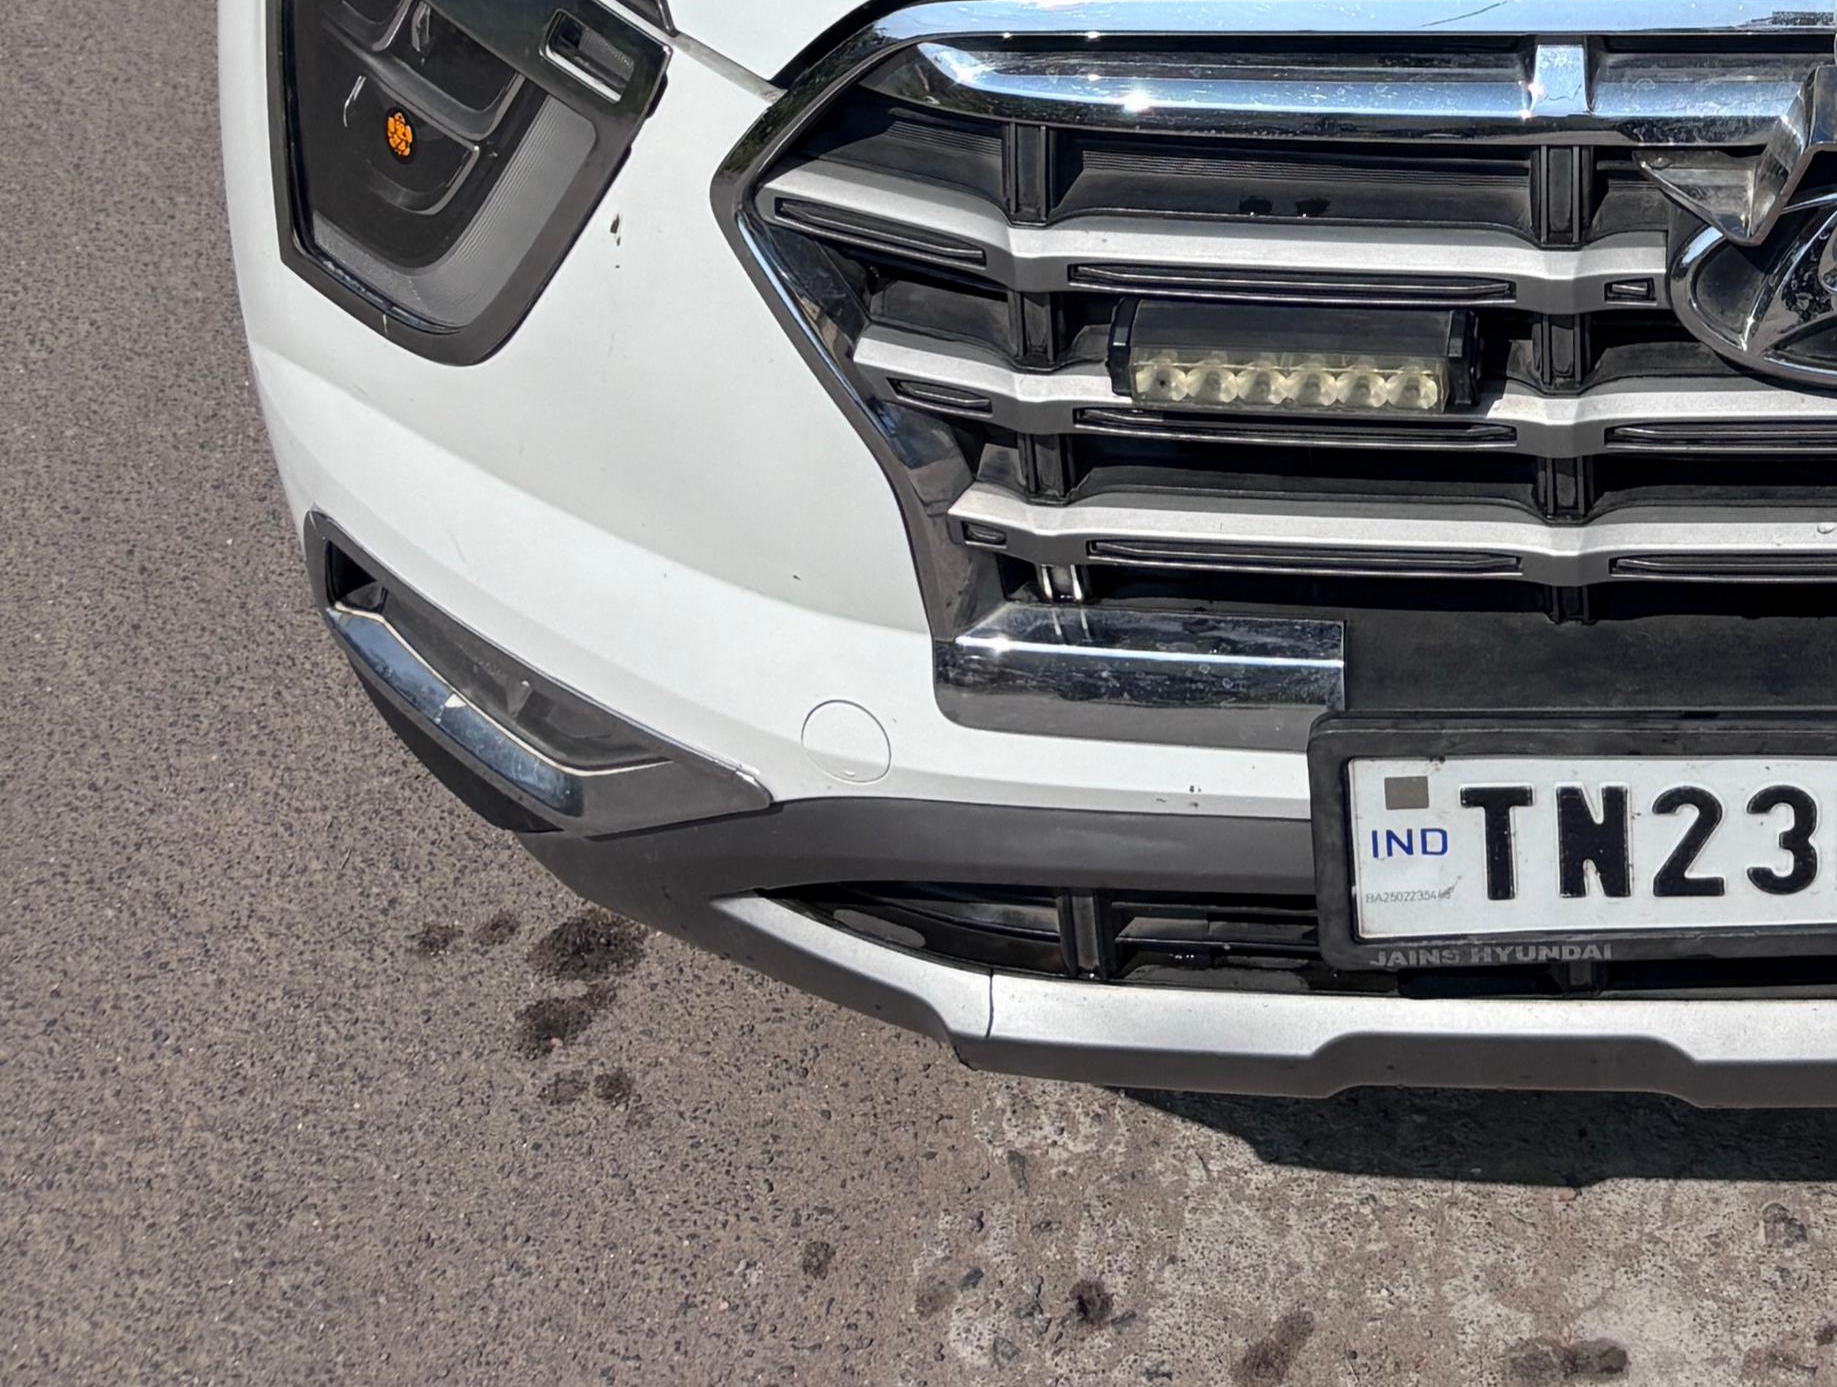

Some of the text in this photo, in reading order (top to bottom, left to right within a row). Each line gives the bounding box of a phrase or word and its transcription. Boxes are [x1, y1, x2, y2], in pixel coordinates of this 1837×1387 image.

[1371, 828, 1449, 858] IND
[1370, 943, 1612, 967] JAINS HYUNDAI
